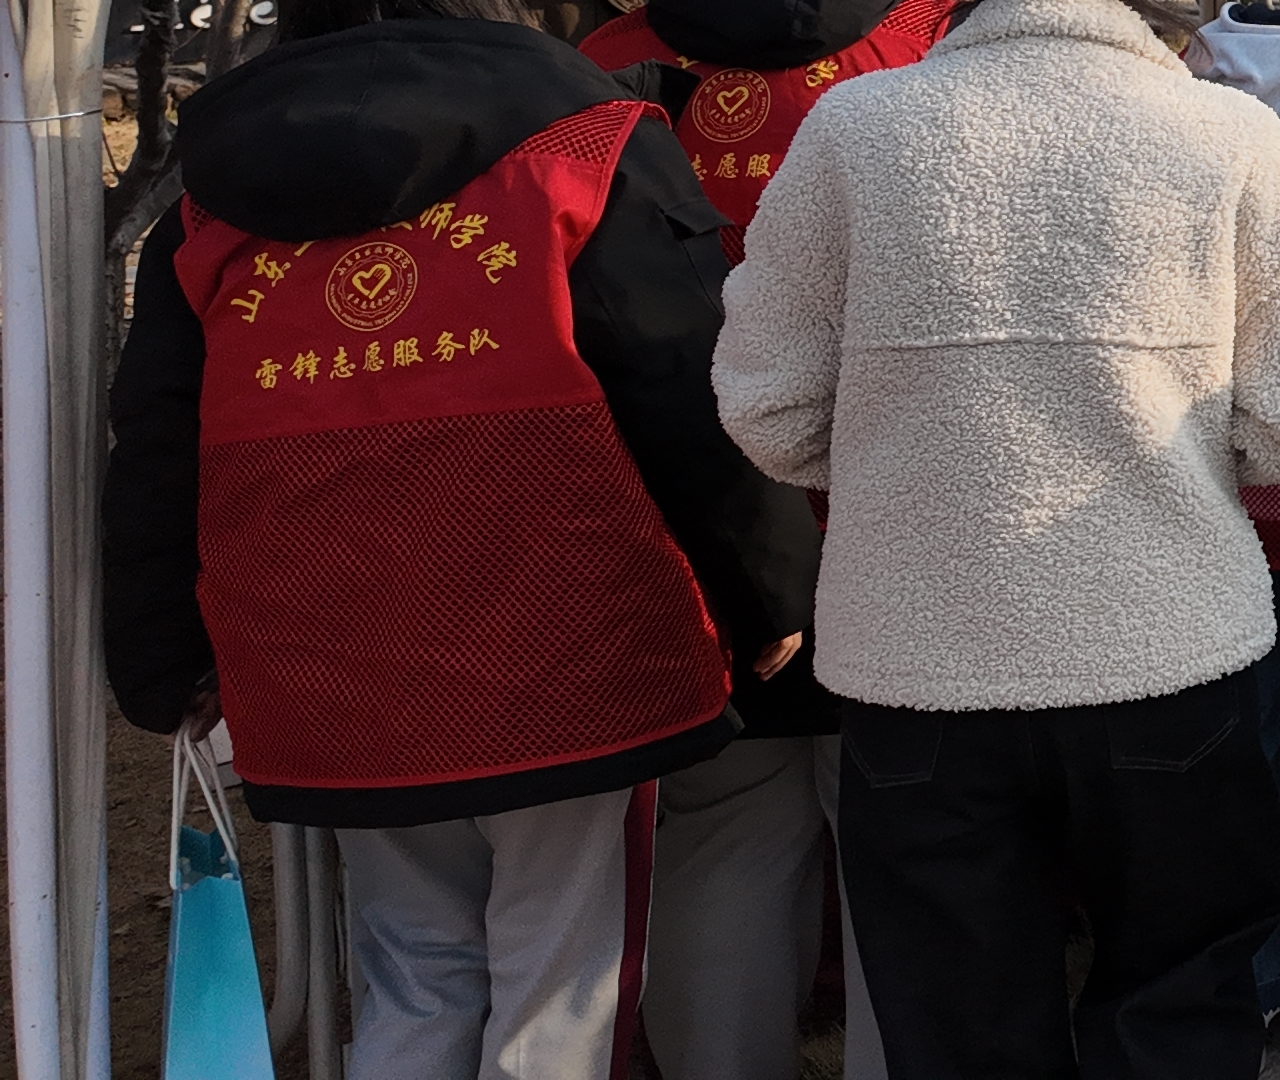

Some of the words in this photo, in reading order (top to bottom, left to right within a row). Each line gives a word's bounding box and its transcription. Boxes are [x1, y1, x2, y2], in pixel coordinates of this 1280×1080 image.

[255, 328, 500, 390] 雷锋志愿服务队
